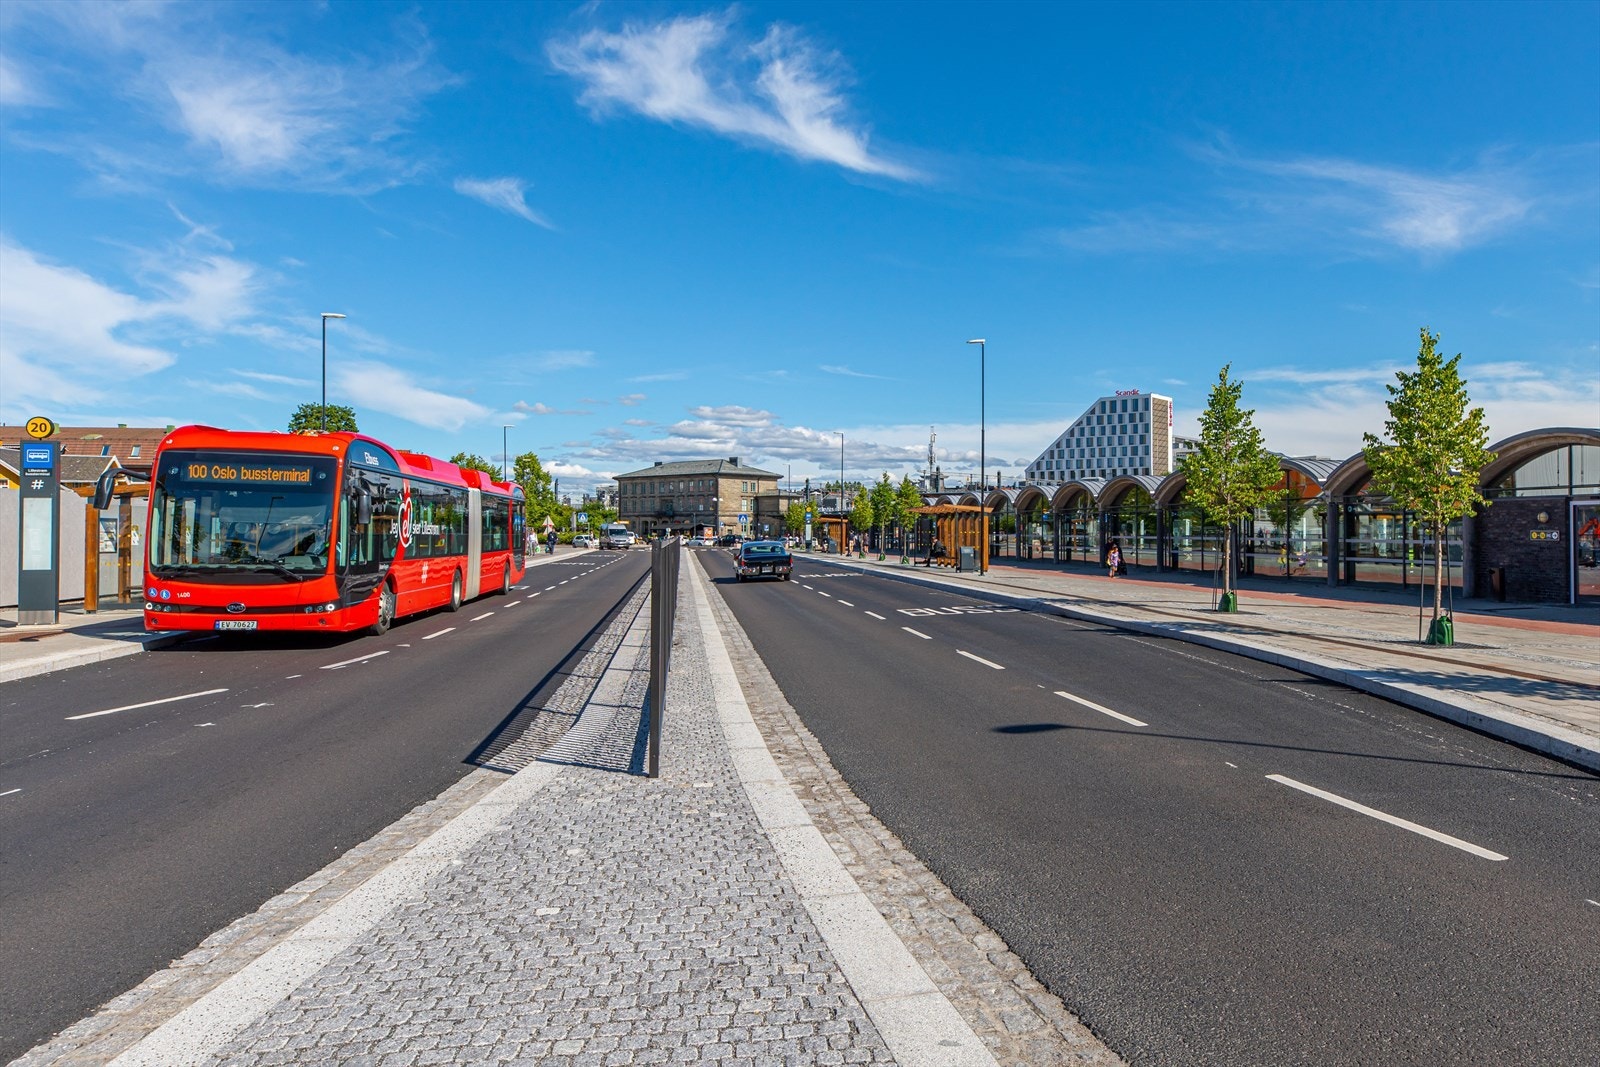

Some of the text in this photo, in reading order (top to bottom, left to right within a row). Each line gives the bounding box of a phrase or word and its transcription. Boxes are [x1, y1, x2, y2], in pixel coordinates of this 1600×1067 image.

[30, 422, 47, 433] 20
[188, 464, 310, 482] 100 Oslo bussterminal
